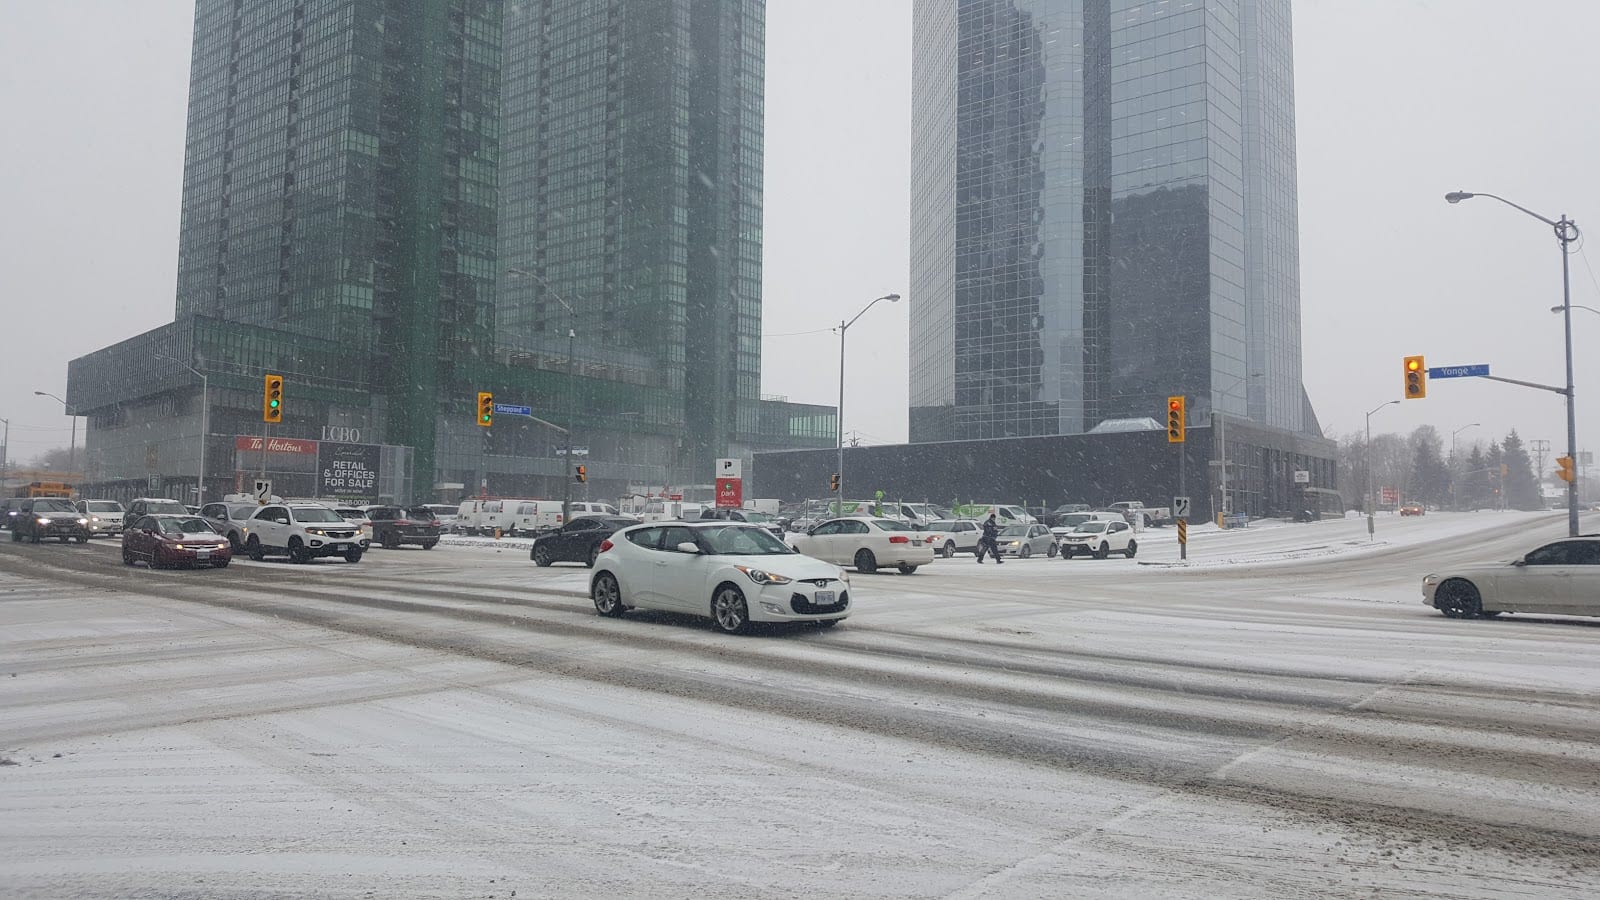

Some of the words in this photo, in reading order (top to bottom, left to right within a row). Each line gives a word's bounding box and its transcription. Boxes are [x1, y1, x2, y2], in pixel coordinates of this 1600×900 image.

[1441, 366, 1469, 377] Yonge
[497, 405, 522, 414] Sheppard
[321, 425, 360, 443] LCBO
[268, 439, 301, 452] Hortons
[333, 460, 367, 470] RETAIL
[323, 469, 331, 478] &
[334, 469, 375, 480] OFFICES
[325, 478, 345, 487] FOR
[348, 479, 373, 489] SALE
[720, 489, 736, 498] park
